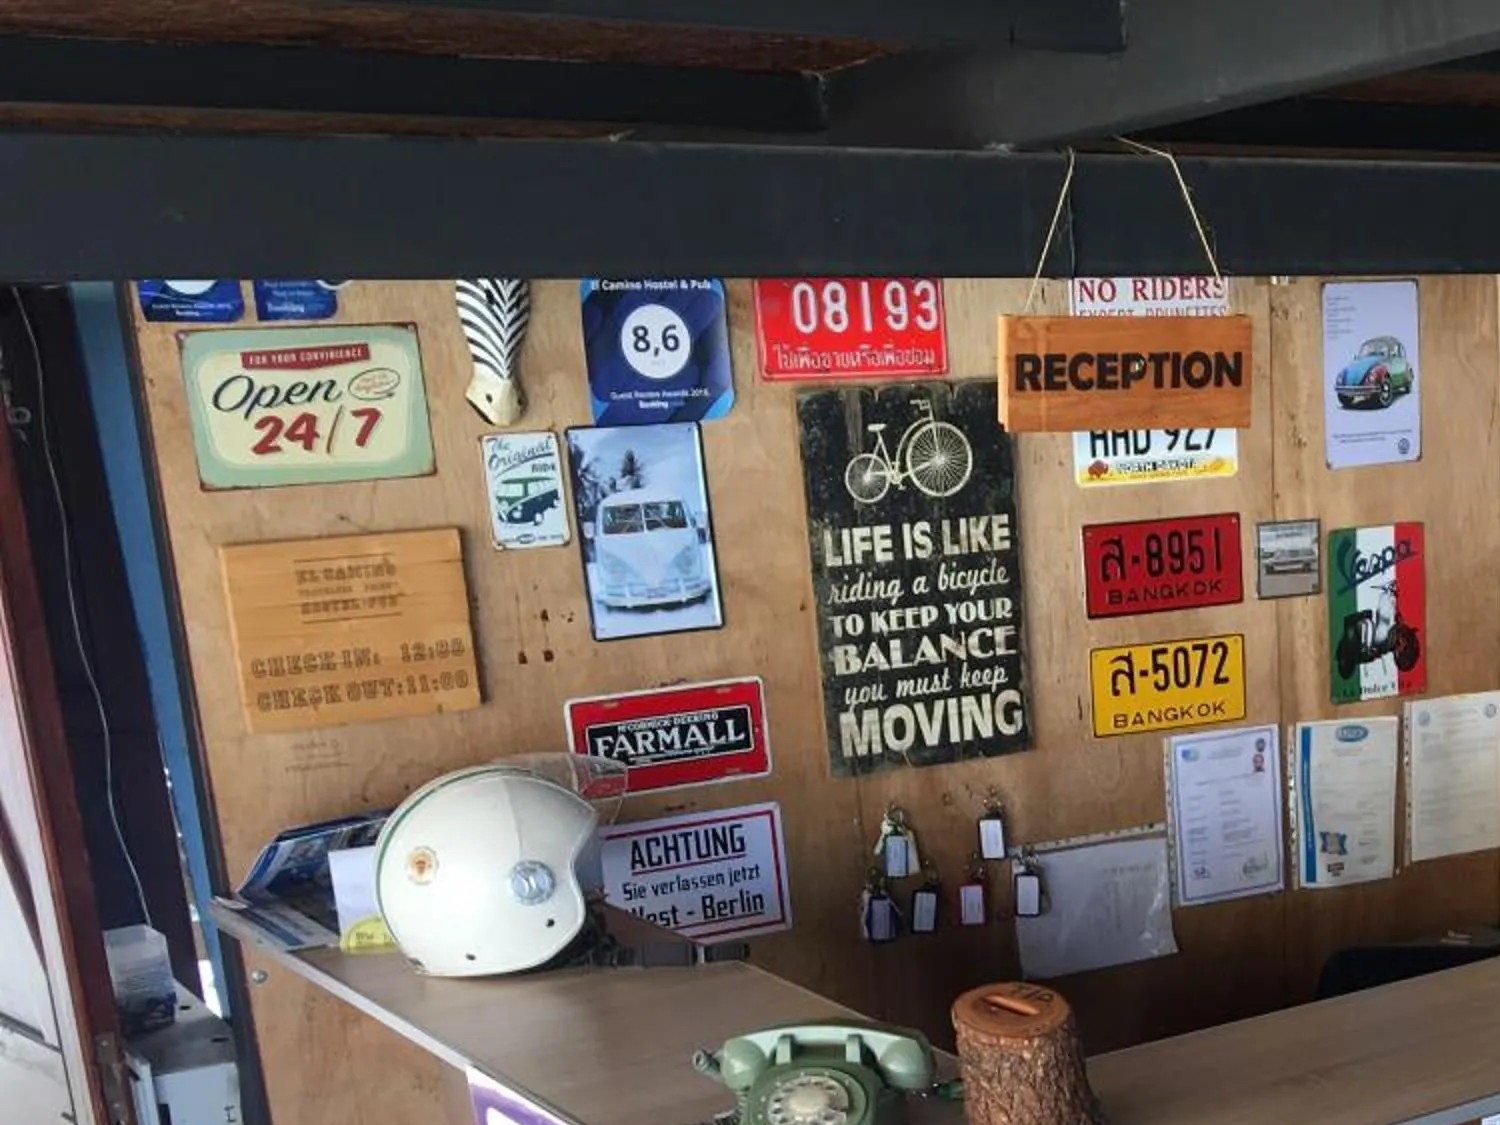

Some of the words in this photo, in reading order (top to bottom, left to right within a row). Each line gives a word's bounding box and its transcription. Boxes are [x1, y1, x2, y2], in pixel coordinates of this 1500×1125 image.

[793, 281, 938, 335] 08193
[1079, 280, 1117, 303] NO
[1132, 277, 1225, 300] RIDERS
[248, 354, 267, 366] FOR
[271, 351, 297, 365] YOUR
[632, 325, 681, 360] 8,6
[1014, 351, 1243, 392] RECEPTION
[213, 375, 343, 419] Open
[251, 405, 382, 454] 24/7
[824, 524, 894, 567] LIFE
[902, 521, 934, 560] IS
[942, 513, 1012, 555] LIKE
[828, 571, 905, 606] riding
[912, 576, 931, 595] a
[938, 557, 1010, 596] bicycle
[1108, 580, 1223, 605] BANGKOK
[829, 613, 865, 639] TO
[871, 603, 939, 637] KEEP
[944, 597, 1013, 626] YOUR
[252, 650, 337, 680] CHECK
[400, 638, 466, 665] 12:00
[829, 625, 1018, 676] BALANCE
[256, 683, 342, 713] CHECK
[845, 684, 888, 711] you
[895, 667, 952, 698] must
[960, 661, 1009, 692] keep
[839, 689, 1024, 758] MOVING
[1113, 701, 1226, 729] BANGKOK
[594, 718, 746, 759] FARMALL
[630, 823, 747, 871] ACHTUNG
[622, 881, 648, 901] Sie
[651, 872, 726, 898] verlassen
[729, 862, 761, 886] jetzt
[701, 890, 766, 921] Berlin
